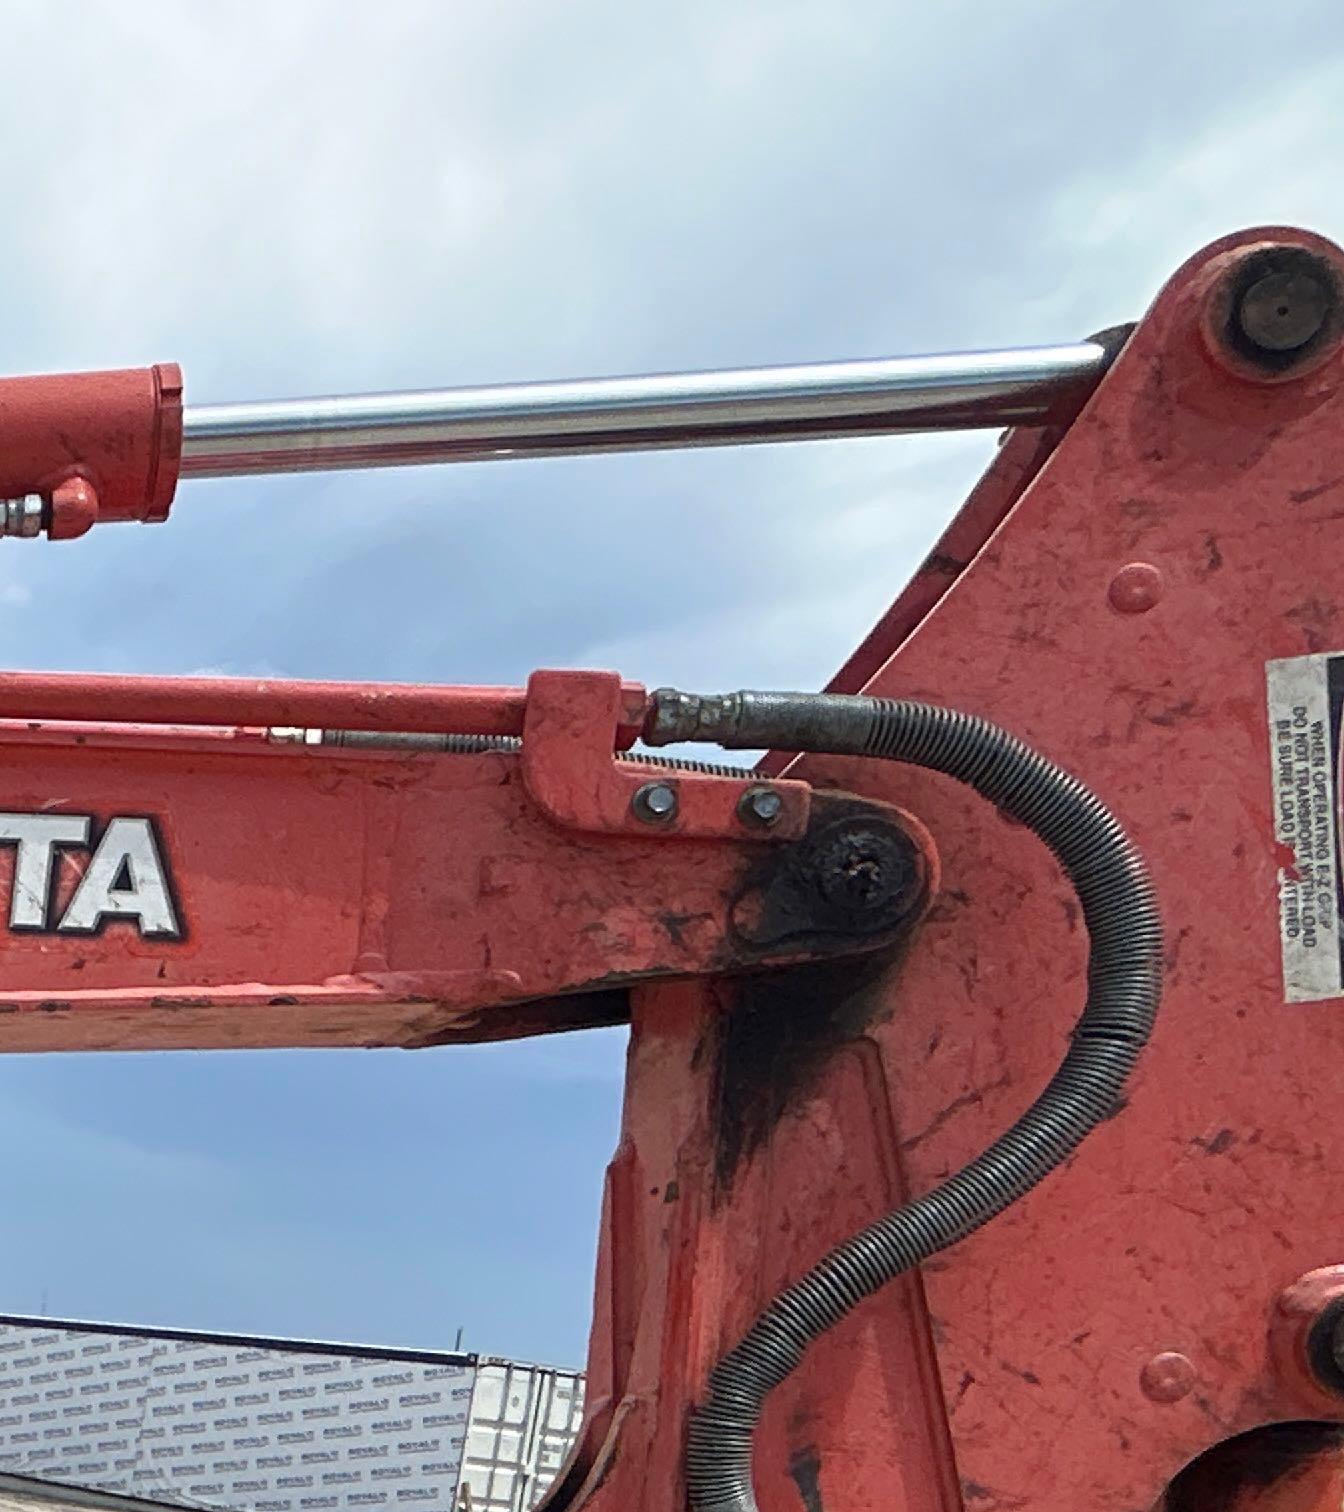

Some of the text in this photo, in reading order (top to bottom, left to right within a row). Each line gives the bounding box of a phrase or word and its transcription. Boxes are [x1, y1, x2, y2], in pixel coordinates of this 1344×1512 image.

[1293, 706, 1308, 728] DO
[1294, 732, 1310, 762] NOT
[1302, 906, 1317, 948] LOAD
